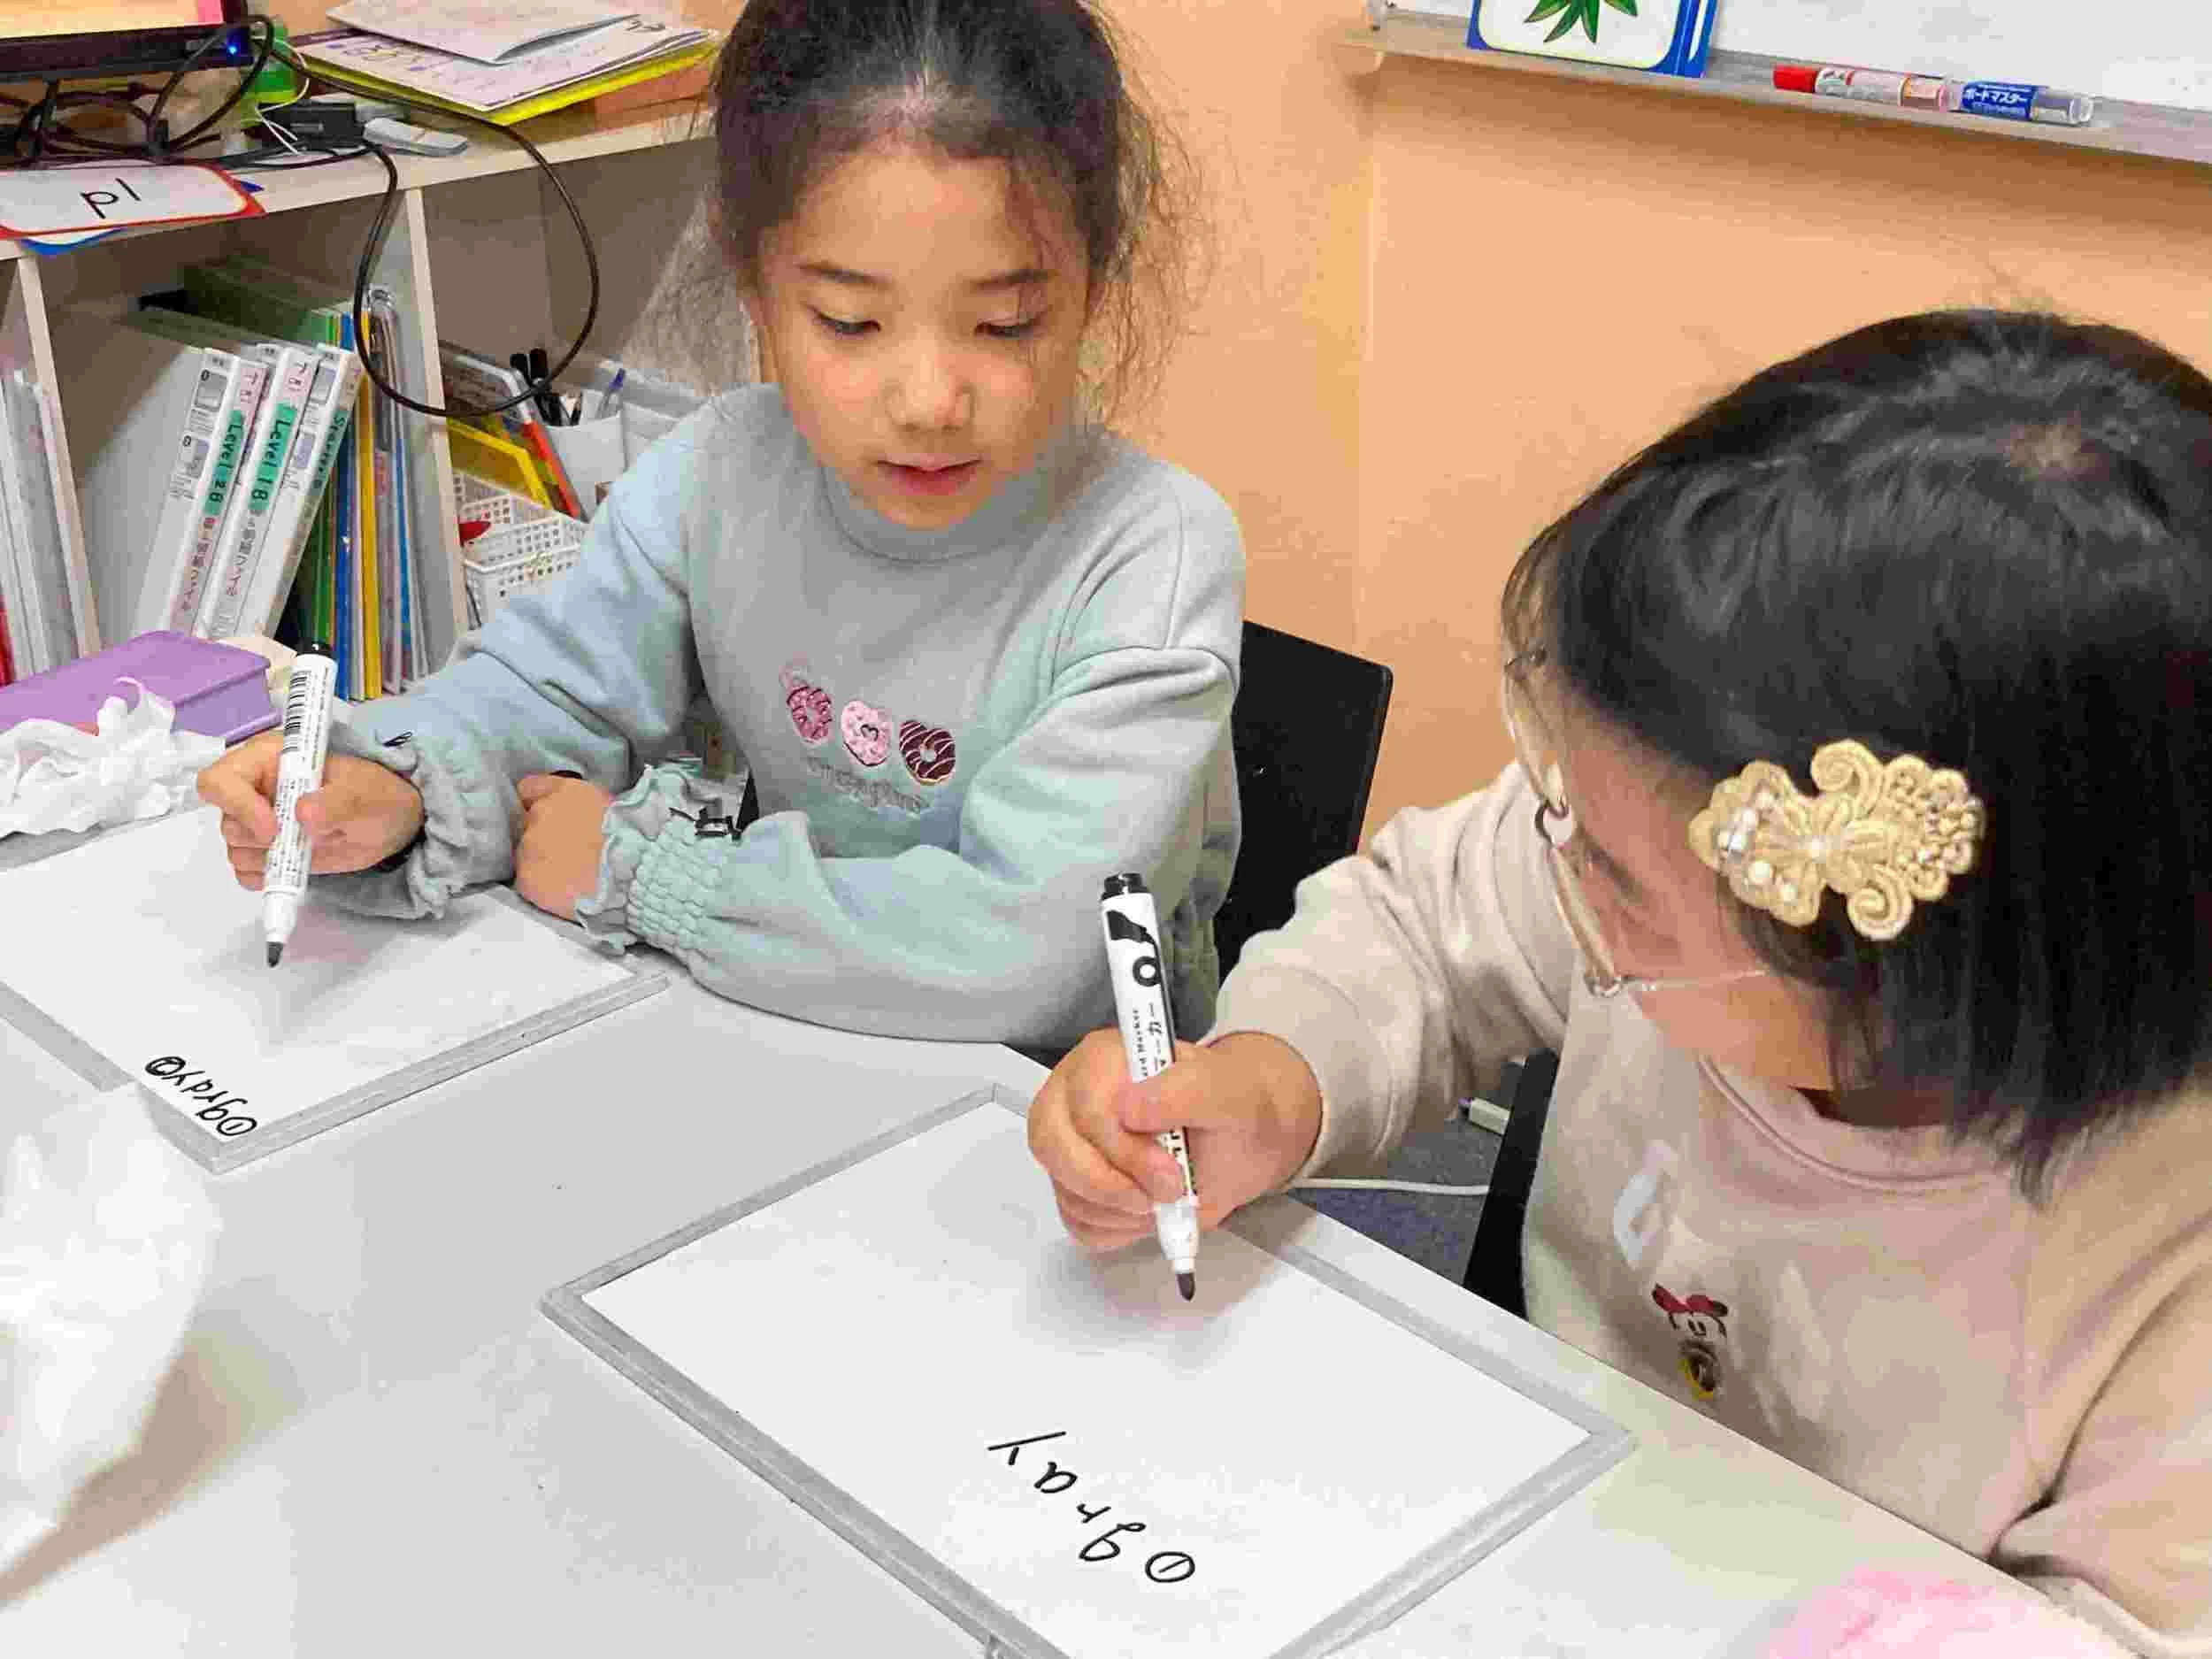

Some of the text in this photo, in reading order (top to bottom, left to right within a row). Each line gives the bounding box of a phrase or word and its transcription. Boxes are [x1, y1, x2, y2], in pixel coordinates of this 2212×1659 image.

[80, 177, 142, 219] pl
[219, 423, 243, 474] Level
[265, 418, 292, 468] Level
[987, 1430, 1148, 1563] gray
